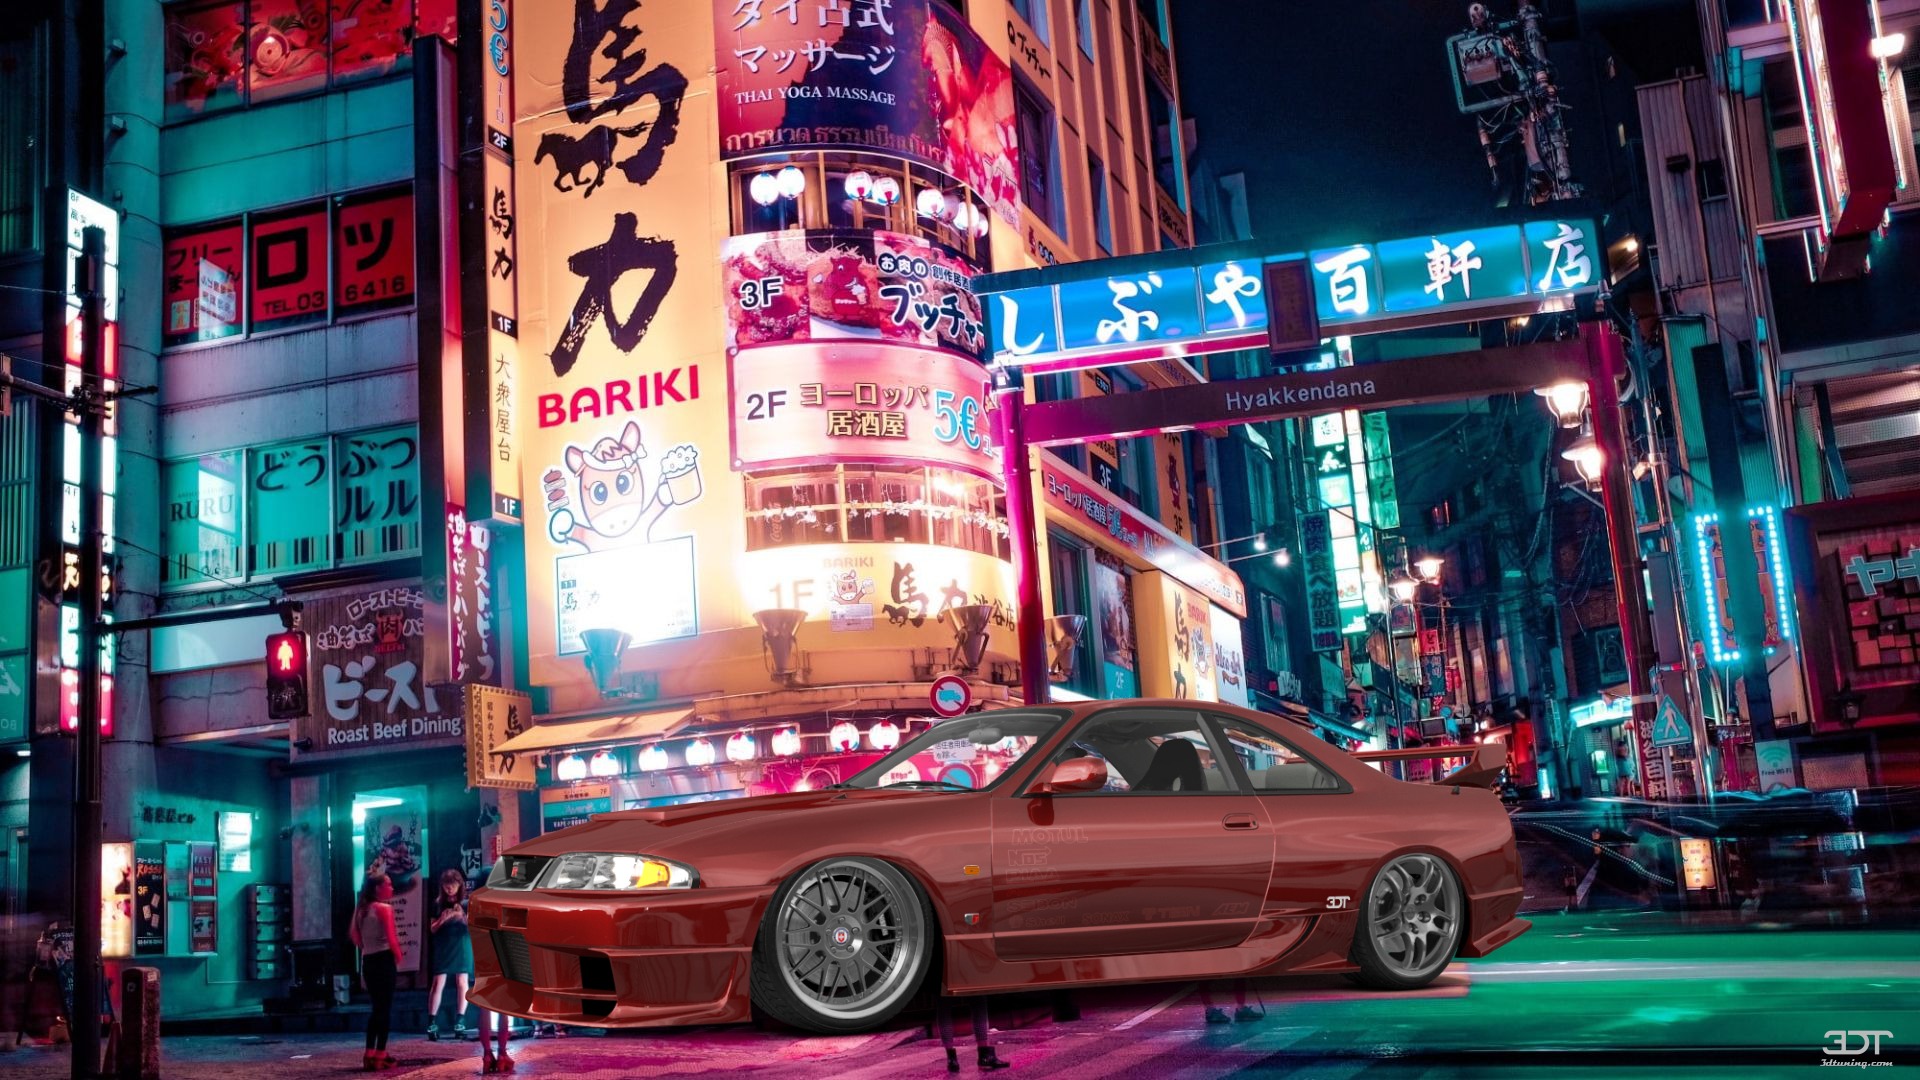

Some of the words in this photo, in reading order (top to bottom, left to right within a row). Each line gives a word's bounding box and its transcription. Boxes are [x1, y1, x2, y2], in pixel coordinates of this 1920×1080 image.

[734, 37, 896, 75] マッサージ
[735, 88, 774, 105] THAI
[777, 86, 823, 100] YOGA
[827, 86, 897, 106] MASSAGE
[493, 131, 508, 149] 2F
[544, 0, 690, 377] 馬力
[490, 184, 514, 281] 馬力
[880, 254, 928, 278] お肉の
[345, 275, 406, 302] 6416
[740, 277, 785, 310] 3F
[498, 316, 512, 333] 1F
[538, 364, 701, 429] BARIKI
[746, 390, 788, 421] 2F
[799, 382, 930, 408] ヨーロッパ
[1226, 379, 1376, 412] Hyakkendana
[826, 409, 908, 439] 居酒屋
[934, 389, 981, 450] 5€
[255, 436, 417, 492] どうぶつ
[1100, 462, 1112, 491] 3F
[170, 493, 234, 522] RURU
[338, 479, 420, 528] ルル
[502, 497, 517, 516] 1F
[1174, 514, 1183, 537] 3F
[823, 556, 875, 569] BARIKI
[469, 523, 496, 682] ローストビーフ
[768, 577, 816, 612] 1F
[317, 623, 377, 650] 油そば
[1115, 671, 1125, 689] 2F
[328, 724, 370, 745] Roast
[373, 719, 409, 740] Beef
[411, 714, 463, 736] Dining
[1761, 769, 1774, 777] Free
[1011, 828, 1089, 845] MOTUL
[193, 866, 213, 876] NAIL
[138, 885, 149, 897] 3F
[1326, 896, 1351, 909] 3DT
